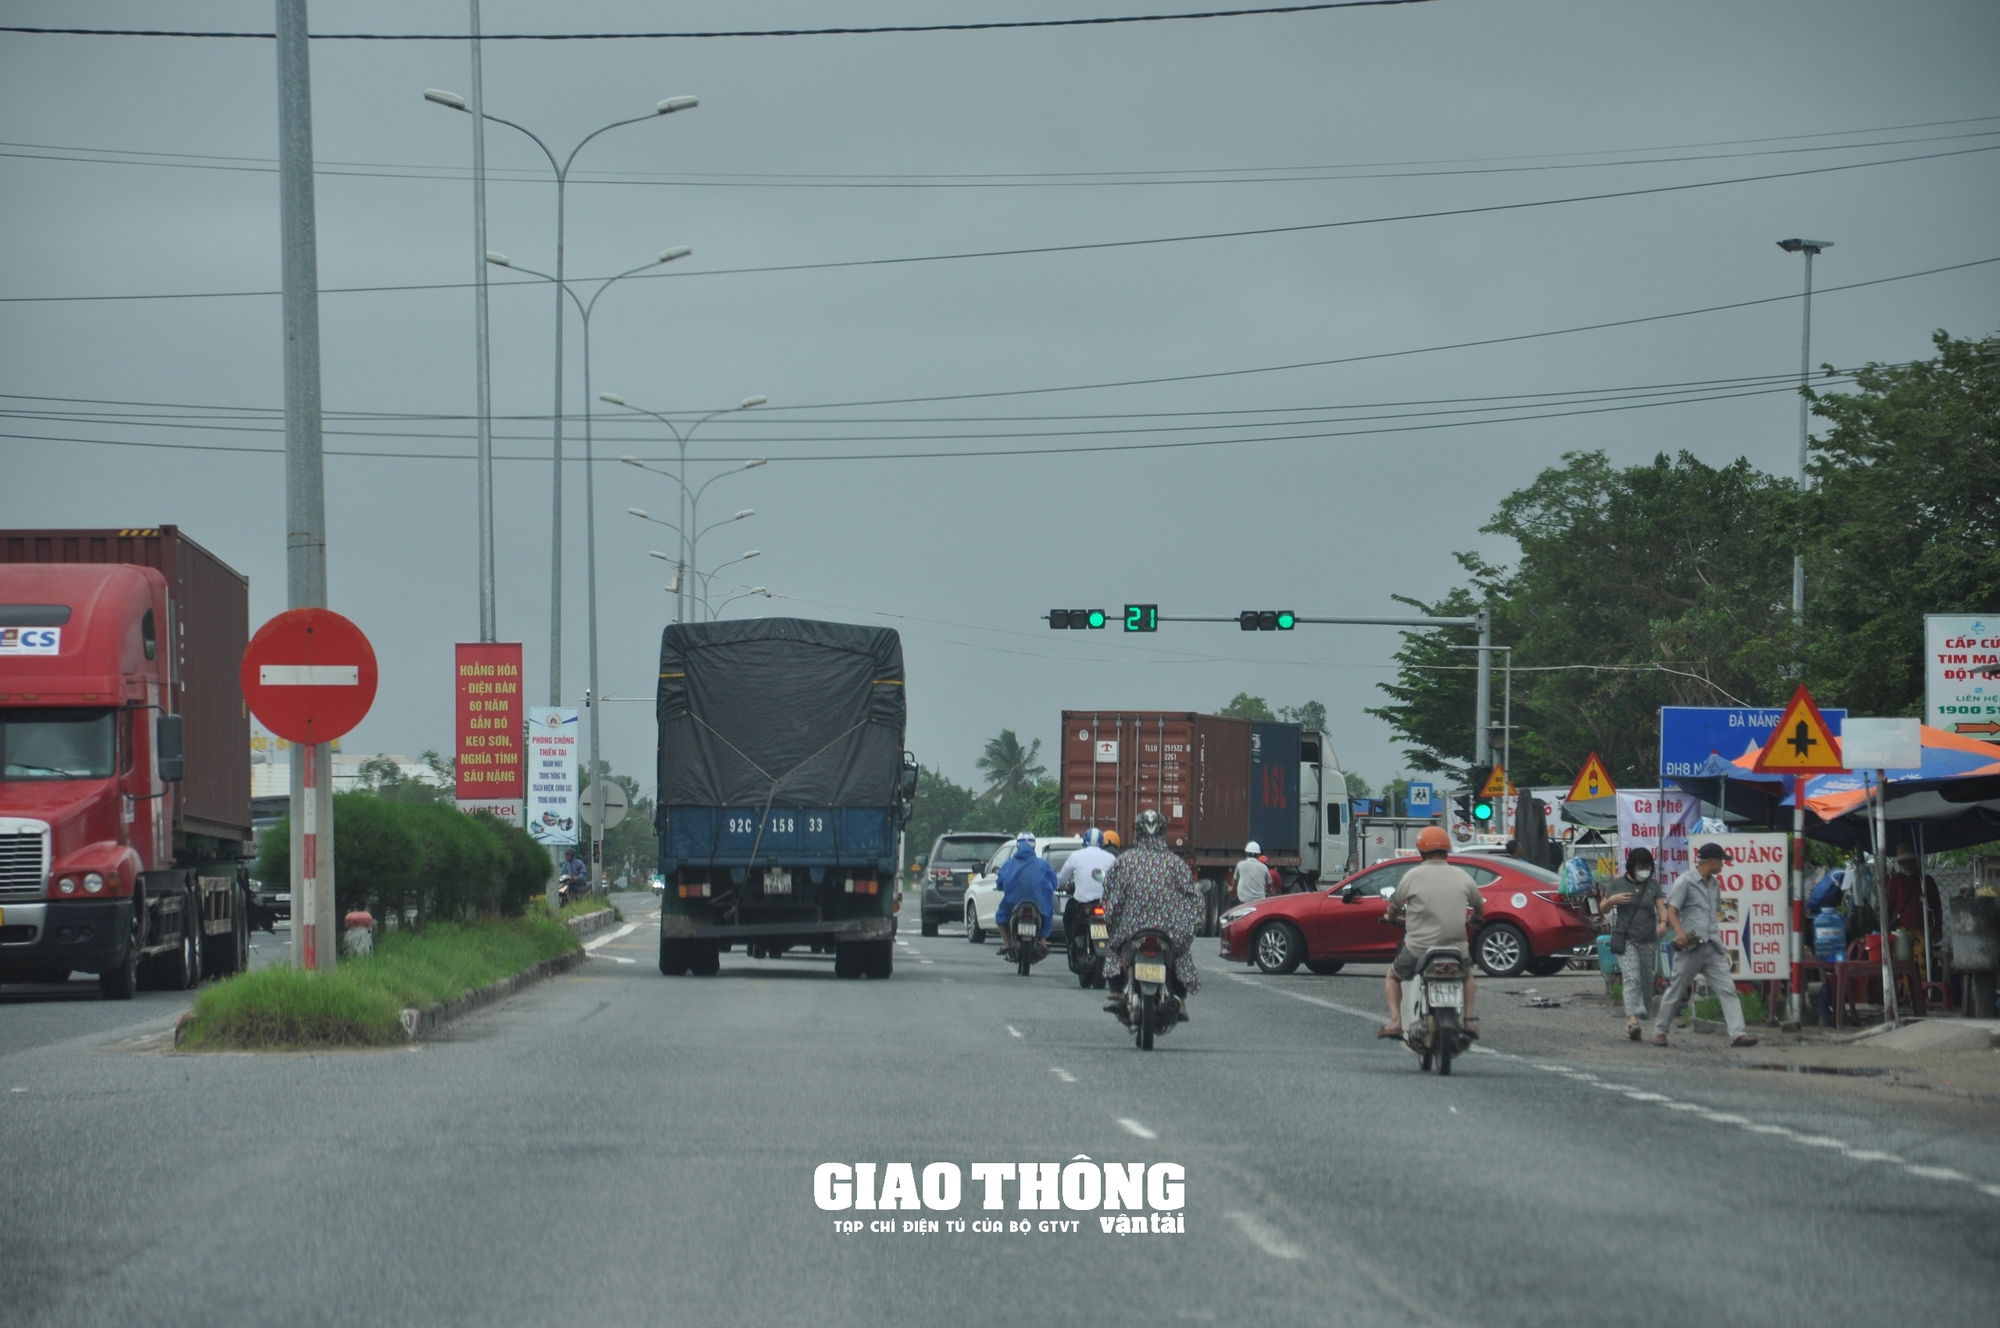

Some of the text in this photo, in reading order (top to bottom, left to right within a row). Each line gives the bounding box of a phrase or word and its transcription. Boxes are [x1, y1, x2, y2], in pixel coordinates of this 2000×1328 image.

[1126, 607, 1155, 631] 21
[1945, 634, 2000, 649] CẤP CỨ
[1937, 654, 1967, 664] TIM
[460, 661, 518, 676] HOẰNG HÓA
[1944, 667, 1975, 682] ĐỘT
[468, 681, 493, 696] ĐIỆN
[495, 679, 516, 693] BÀN
[469, 699, 509, 711] 60 NĂM
[1938, 706, 1981, 714] 1900
[470, 715, 508, 729] GẮN BÓ
[1728, 711, 1746, 727] ĐÀ
[466, 734, 512, 748] KEO SƠN,
[554, 734, 575, 745] CHỐNG
[539, 747, 567, 757] THIÊN TAI
[1145, 744, 1158, 752] TLLU
[1164, 744, 1183, 752] 251522
[460, 752, 518, 765] NGHĨA TÌNH
[1666, 762, 1691, 775] ĐH8
[463, 769, 515, 785] SÂU NẶNG
[462, 803, 517, 816] viettel
[1634, 799, 1652, 813] Cà
[729, 817, 823, 834] 92C 158 33
[1669, 823, 1686, 837] Mì
[1751, 869, 1782, 891] BÒ
[1753, 959, 1776, 974] GIÒ
